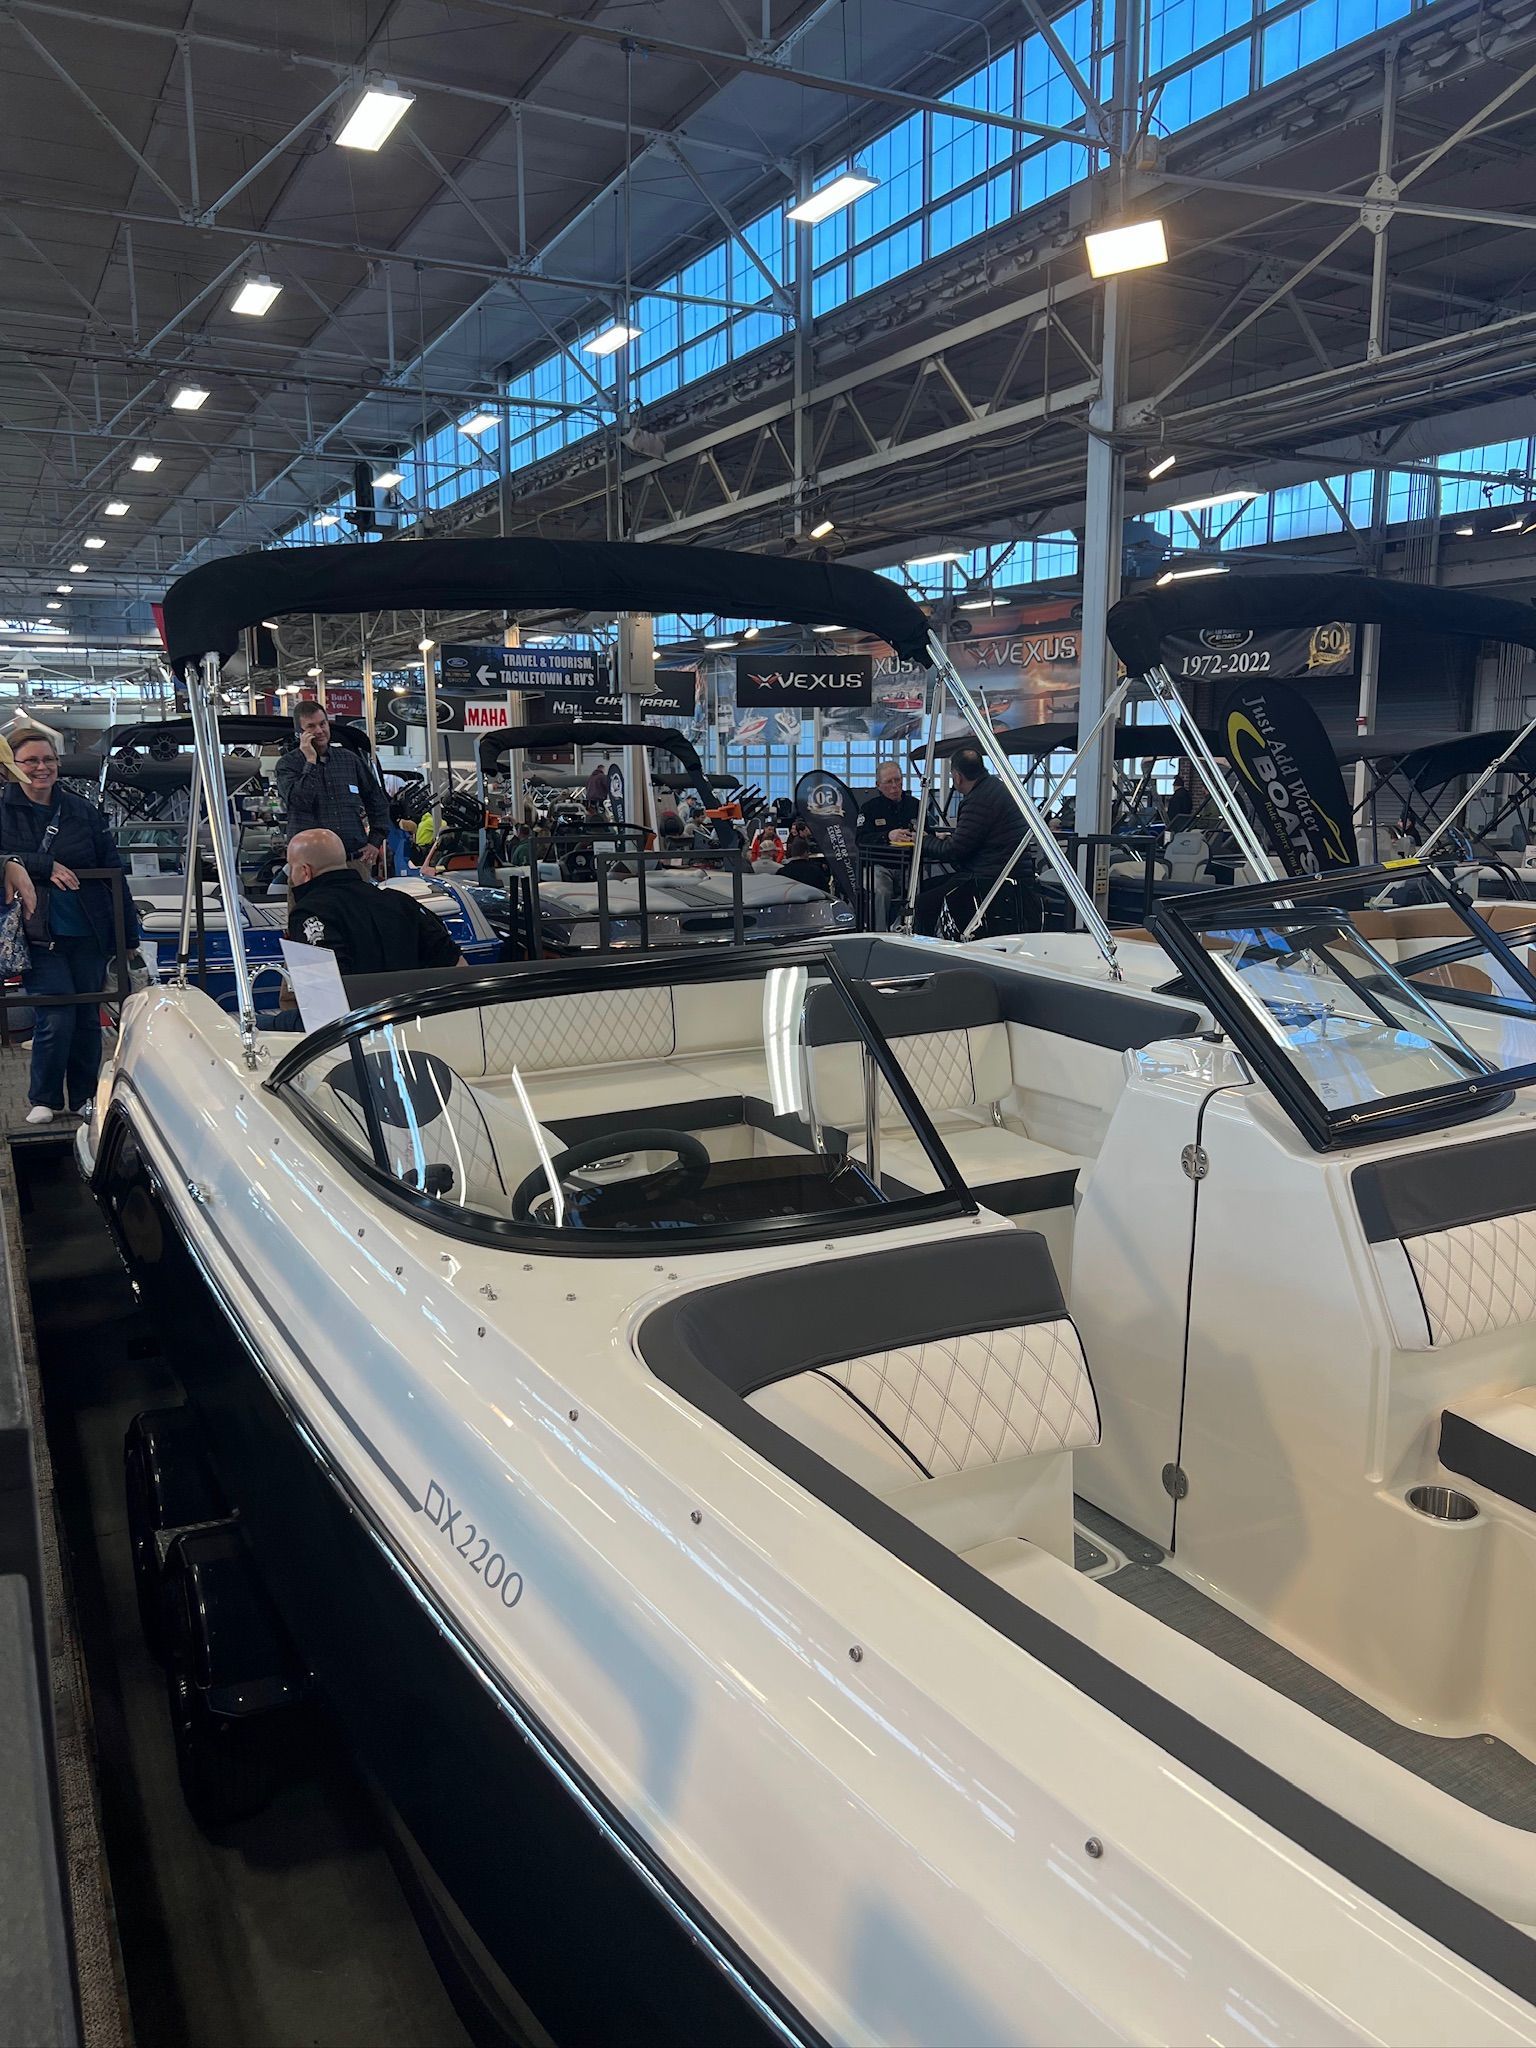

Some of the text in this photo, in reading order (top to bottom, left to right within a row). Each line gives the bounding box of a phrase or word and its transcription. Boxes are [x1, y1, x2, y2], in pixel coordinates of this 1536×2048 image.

[1320, 629, 1341, 650] 50
[503, 653, 595, 670] TRAVEL & TOURISM,
[992, 636, 1076, 668] VEXUS
[1180, 651, 1271, 676] 1972-2022
[500, 670, 595, 686] TACKLETOWN & RV'S
[873, 656, 913, 679] XUS
[775, 671, 862, 690] VEXUS
[595, 696, 680, 708] CHARRAL
[464, 708, 507, 726] MAHA
[1242, 695, 1320, 833] Just Add Water
[1252, 755, 1320, 875] BOATS
[1264, 801, 1277, 826] Ride
[1273, 822, 1290, 850] Before
[1287, 847, 1298, 868] You
[423, 1479, 524, 1608] DX2200
